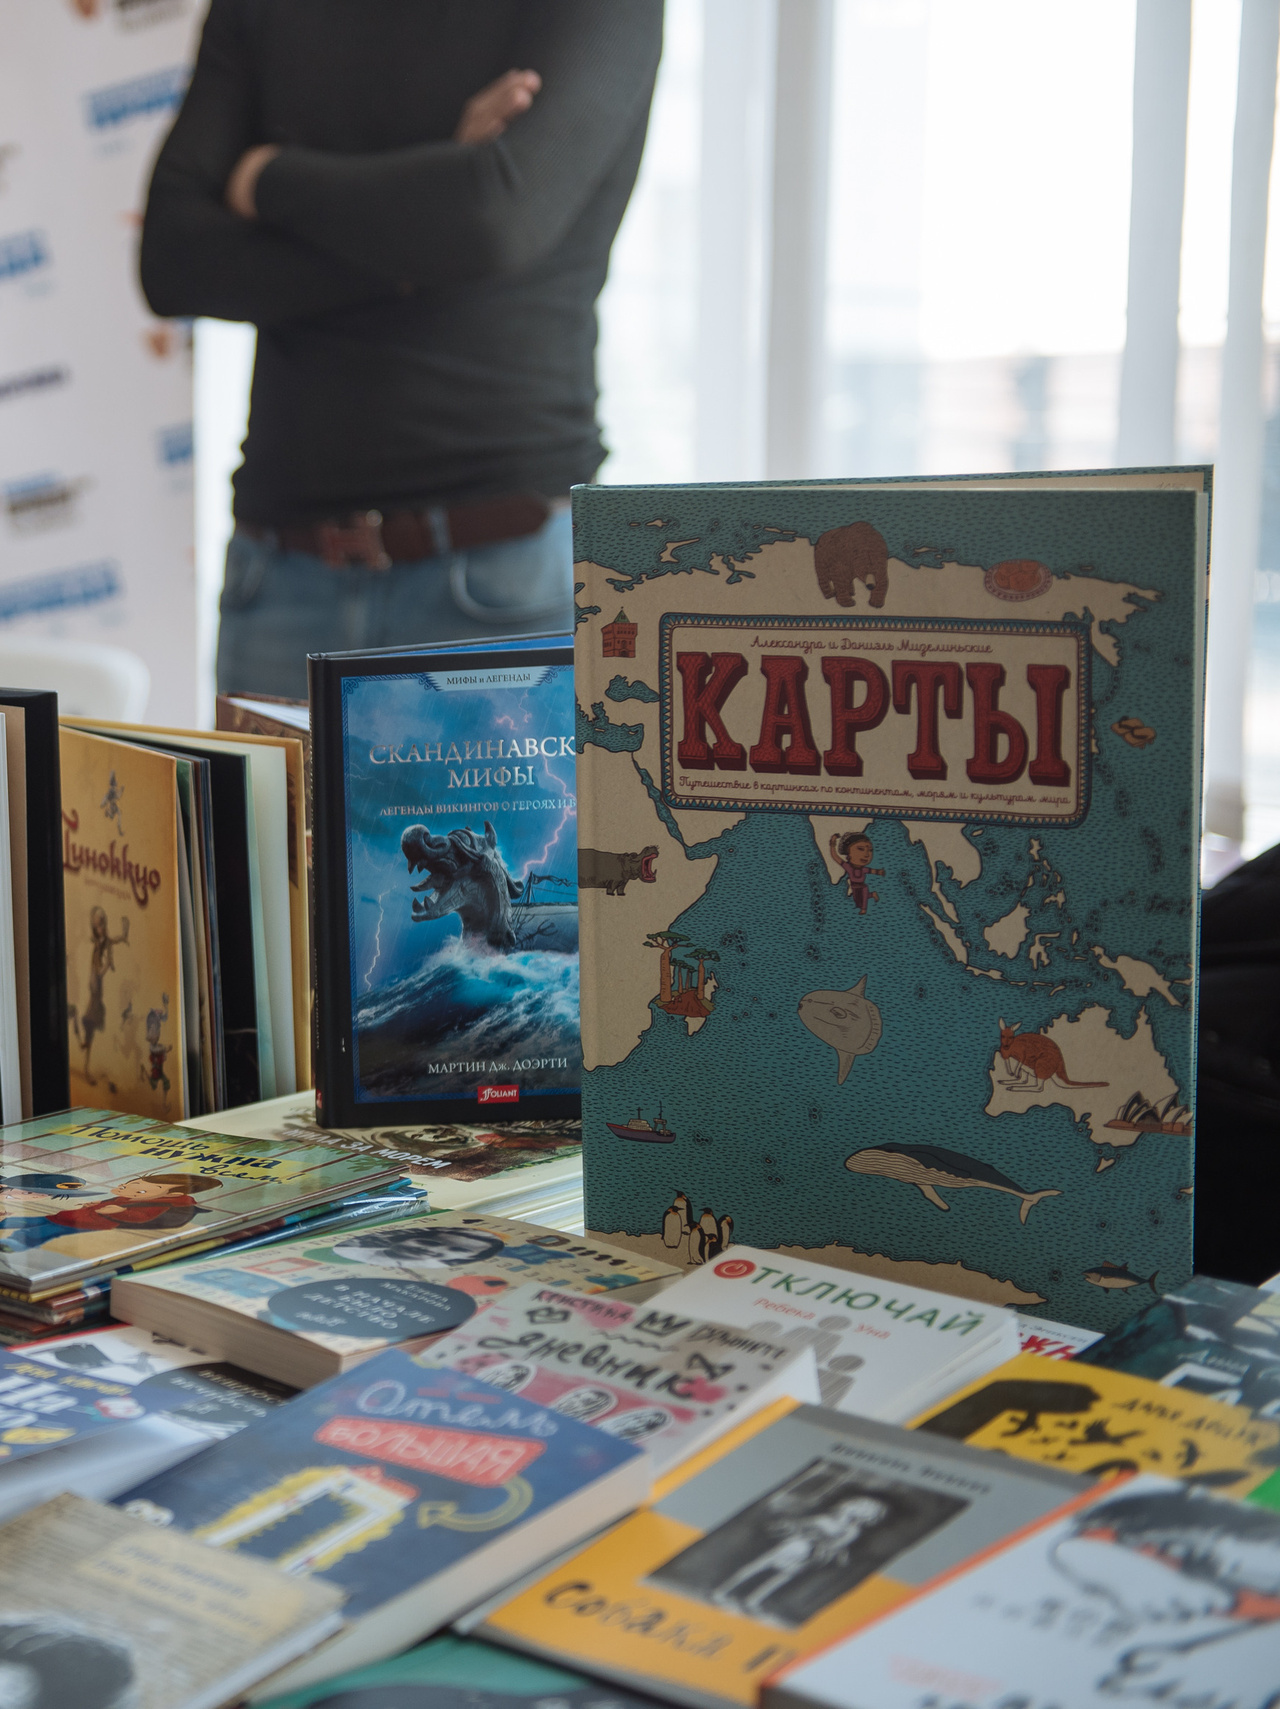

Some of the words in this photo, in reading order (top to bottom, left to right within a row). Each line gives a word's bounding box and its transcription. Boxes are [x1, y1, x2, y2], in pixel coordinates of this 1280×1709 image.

[750, 636, 826, 654] Александра
[828, 641, 838, 649] и
[841, 637, 894, 651] Даниэль
[896, 639, 994, 657] Мизелиньские
[446, 675, 477, 685] МИФЫ
[486, 673, 531, 683] ЛЕГЕНДЫ
[676, 651, 1071, 787] КАРТЫ
[447, 765, 536, 789] МИФЫ
[678, 775, 752, 791] Путешествие
[753, 780, 760, 790] в
[760, 783, 818, 795] картинках
[820, 785, 834, 794] по
[916, 790, 958, 802] морям
[959, 792, 969, 800] и
[970, 792, 1036, 806] культурам
[1039, 796, 1071, 807] мира
[379, 804, 434, 816] ЛЕГЕНДЫ
[436, 802, 500, 814] ВИКИНГОВ
[502, 801, 510, 811] О
[512, 799, 556, 811] ГЕРОЯХ
[427, 1060, 486, 1074] МАРТИН
[488, 1060, 510, 1073] Дж.
[512, 1058, 568, 1072] ДОЭРТИ
[69, 1125, 210, 1151] Помощь
[341, 1140, 374, 1152] ЗА
[376, 1148, 452, 1169] МОРЕМ
